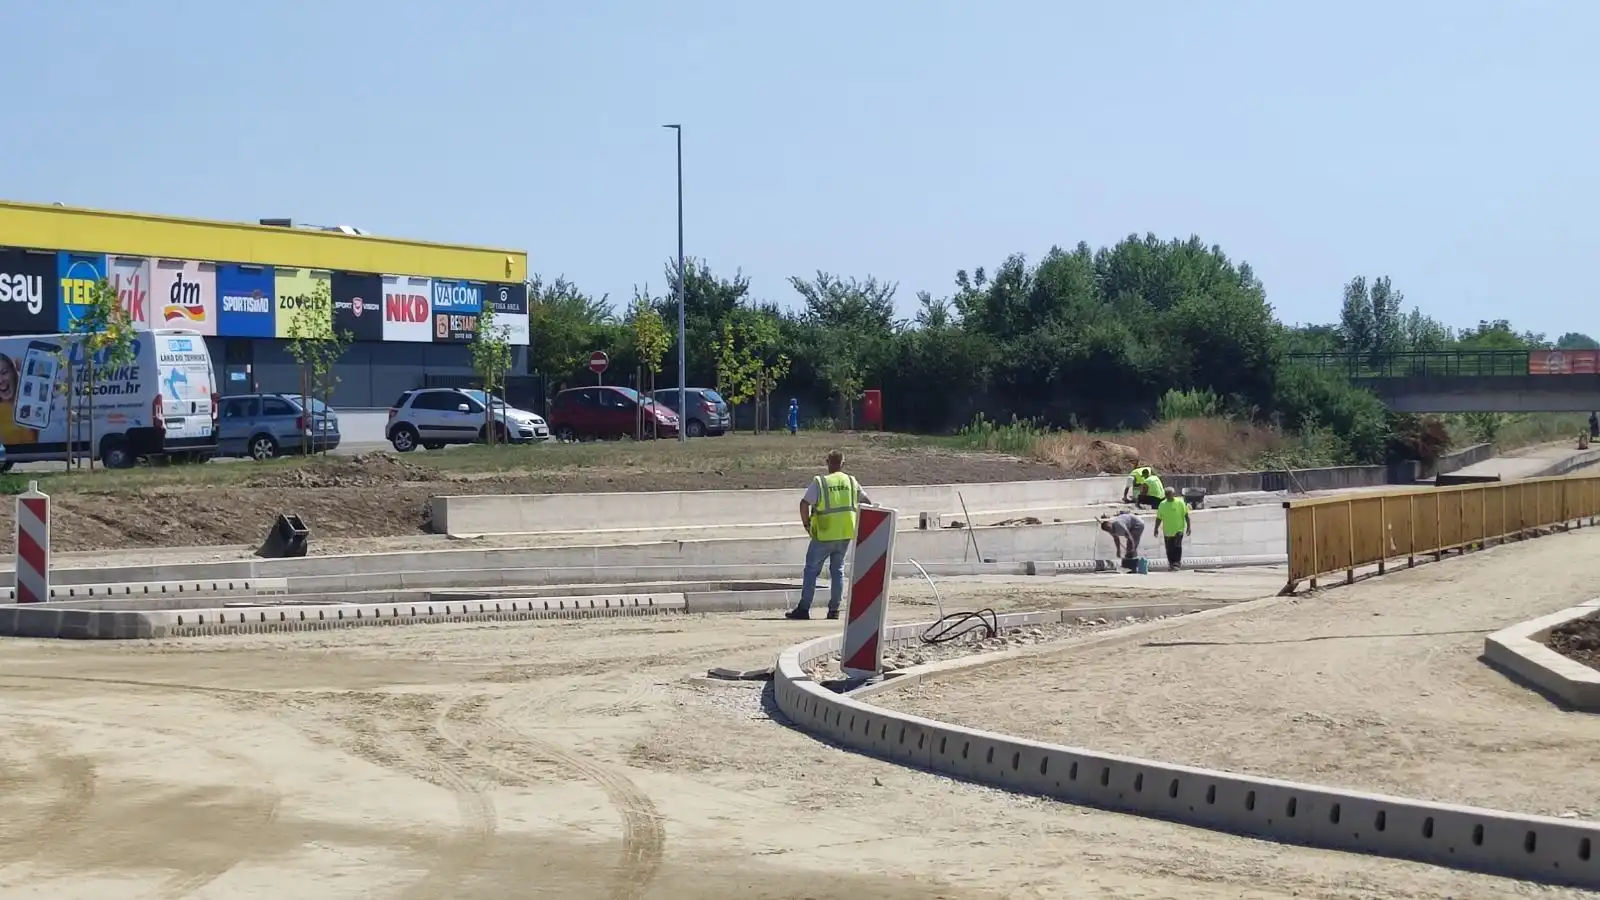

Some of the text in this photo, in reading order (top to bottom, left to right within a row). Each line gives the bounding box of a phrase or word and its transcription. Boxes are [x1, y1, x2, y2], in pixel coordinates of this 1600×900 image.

[0, 273, 43, 315] say
[170, 272, 201, 304] dm
[385, 293, 429, 323] NKD
